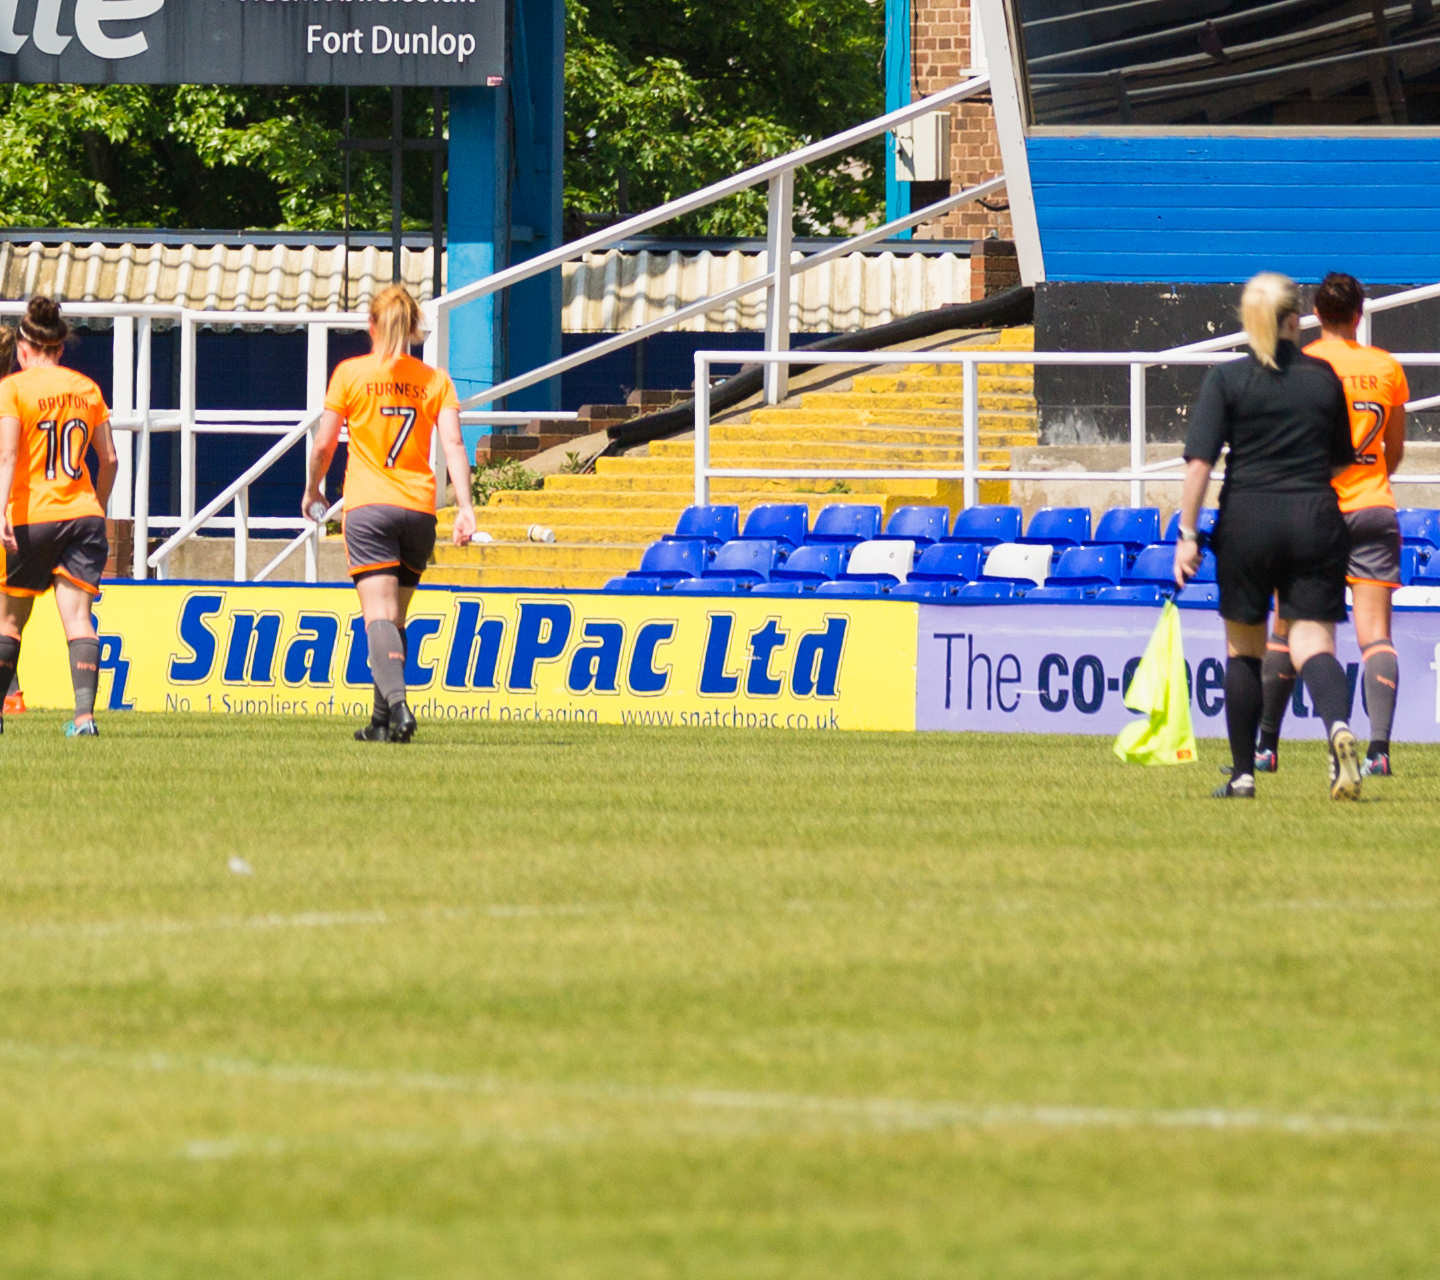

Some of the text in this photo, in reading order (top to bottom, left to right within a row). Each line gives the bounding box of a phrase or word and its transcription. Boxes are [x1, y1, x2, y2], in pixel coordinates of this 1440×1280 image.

[306, 23, 476, 62] Fort Dunlop
[37, 396, 89, 412] BRUTON
[366, 382, 428, 400] FURNESS
[36, 418, 89, 481] 10
[380, 406, 417, 469] 7
[1353, 401, 1385, 465] 2
[168, 590, 681, 700] SnatchPac
[698, 608, 851, 701] Ltd
[933, 632, 1022, 713] The
[205, 695, 212, 712] 1
[221, 693, 308, 715] Suppliers
[315, 695, 336, 715] of
[499, 701, 598, 724] packaging
[621, 705, 840, 730] www.snatchpac.co.uk
